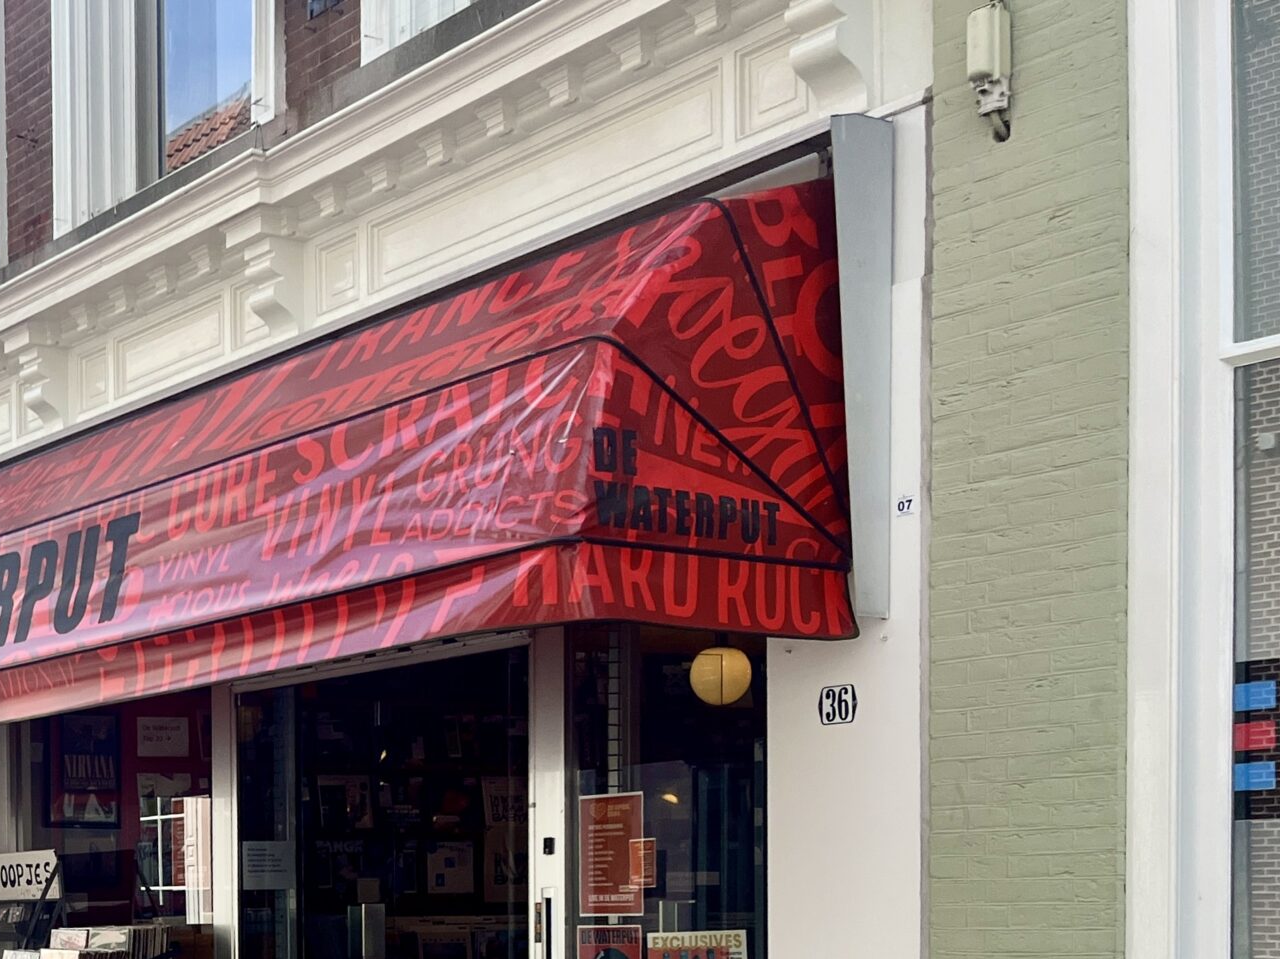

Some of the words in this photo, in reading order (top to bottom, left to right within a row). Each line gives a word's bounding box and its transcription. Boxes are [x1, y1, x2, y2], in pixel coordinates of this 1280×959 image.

[593, 427, 638, 476] DE
[261, 474, 396, 561] VINYL
[400, 490, 589, 545] ADDICTS
[594, 480, 780, 546] WATERPUT
[897, 498, 913, 512] 07
[157, 543, 232, 582] VINYL
[825, 688, 850, 723] 36
[64, 754, 116, 779] NIRVANA
[651, 933, 743, 951] EXCLUSIVES
